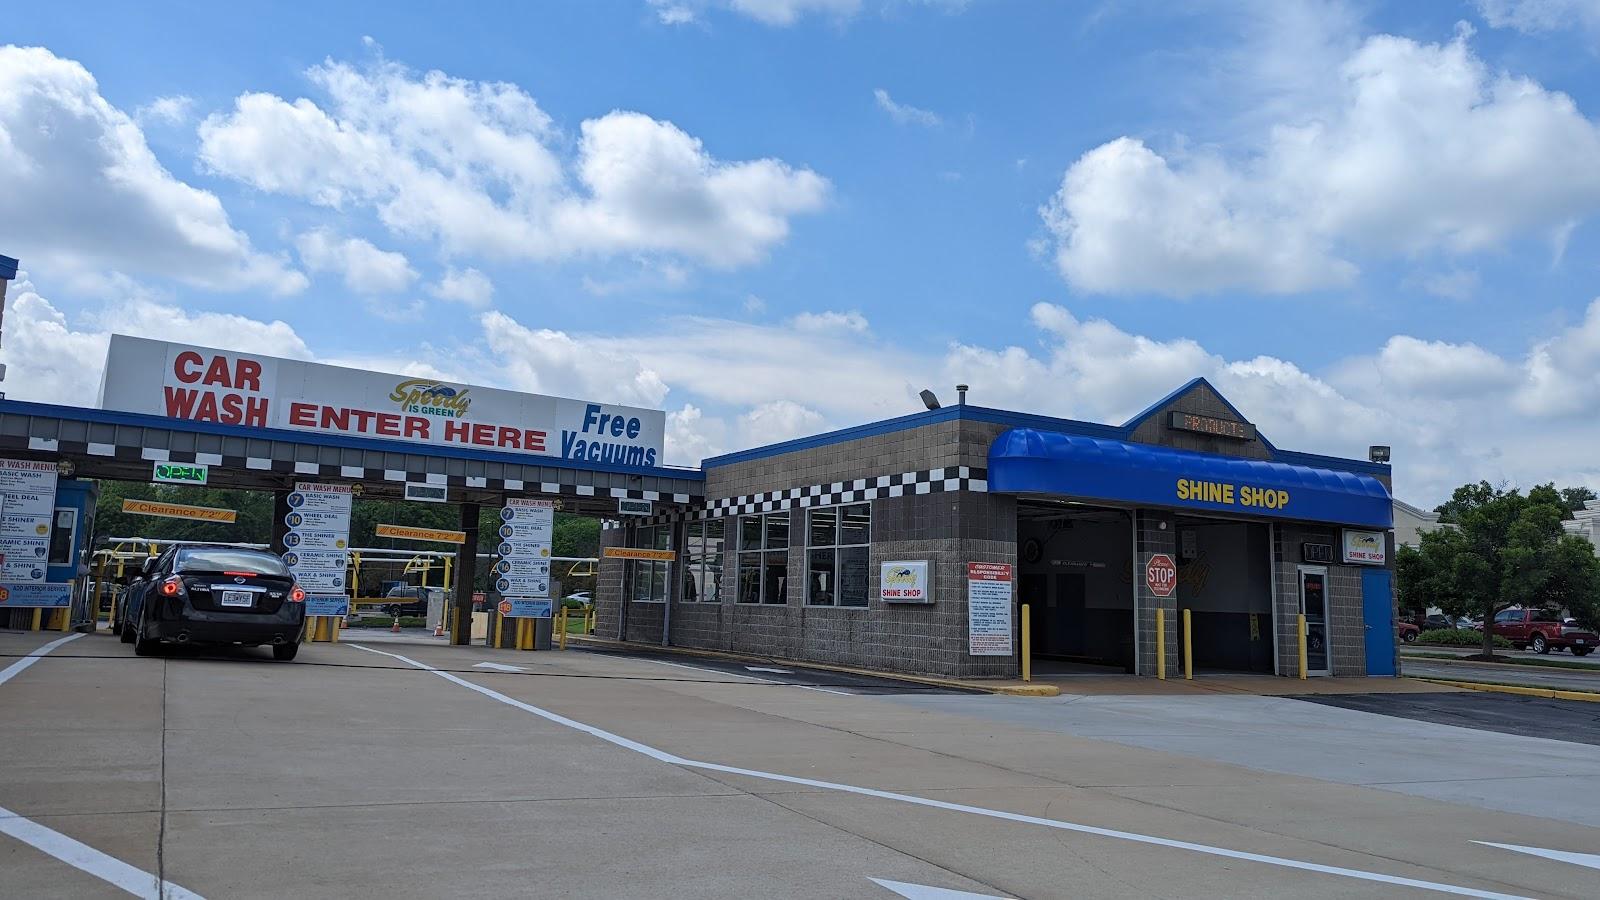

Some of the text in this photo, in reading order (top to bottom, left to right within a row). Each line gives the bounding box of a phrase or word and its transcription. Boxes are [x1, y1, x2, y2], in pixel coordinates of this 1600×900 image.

[173, 350, 262, 392] CAR
[389, 379, 471, 418] Speedy
[164, 386, 269, 429] WASH
[408, 404, 454, 418] IS GREEN
[289, 402, 547, 452] ENTER HERE
[582, 403, 641, 439] Free
[561, 430, 657, 468] Vacuums
[7, 460, 31, 470] WASH
[33, 462, 55, 471] MENU
[156, 465, 206, 482] OPEN
[298, 483, 311, 491] CAR
[313, 484, 332, 492] WASH
[333, 485, 352, 494] MENU
[1176, 478, 1290, 510] SHINE SHOP
[139, 503, 196, 518] Clearance
[389, 528, 435, 539] Clearance
[614, 550, 651, 558] Clearance
[1349, 551, 1366, 559] SHINE
[1148, 567, 1175, 583] STOP
[882, 589, 921, 597] SHINE SHOP
